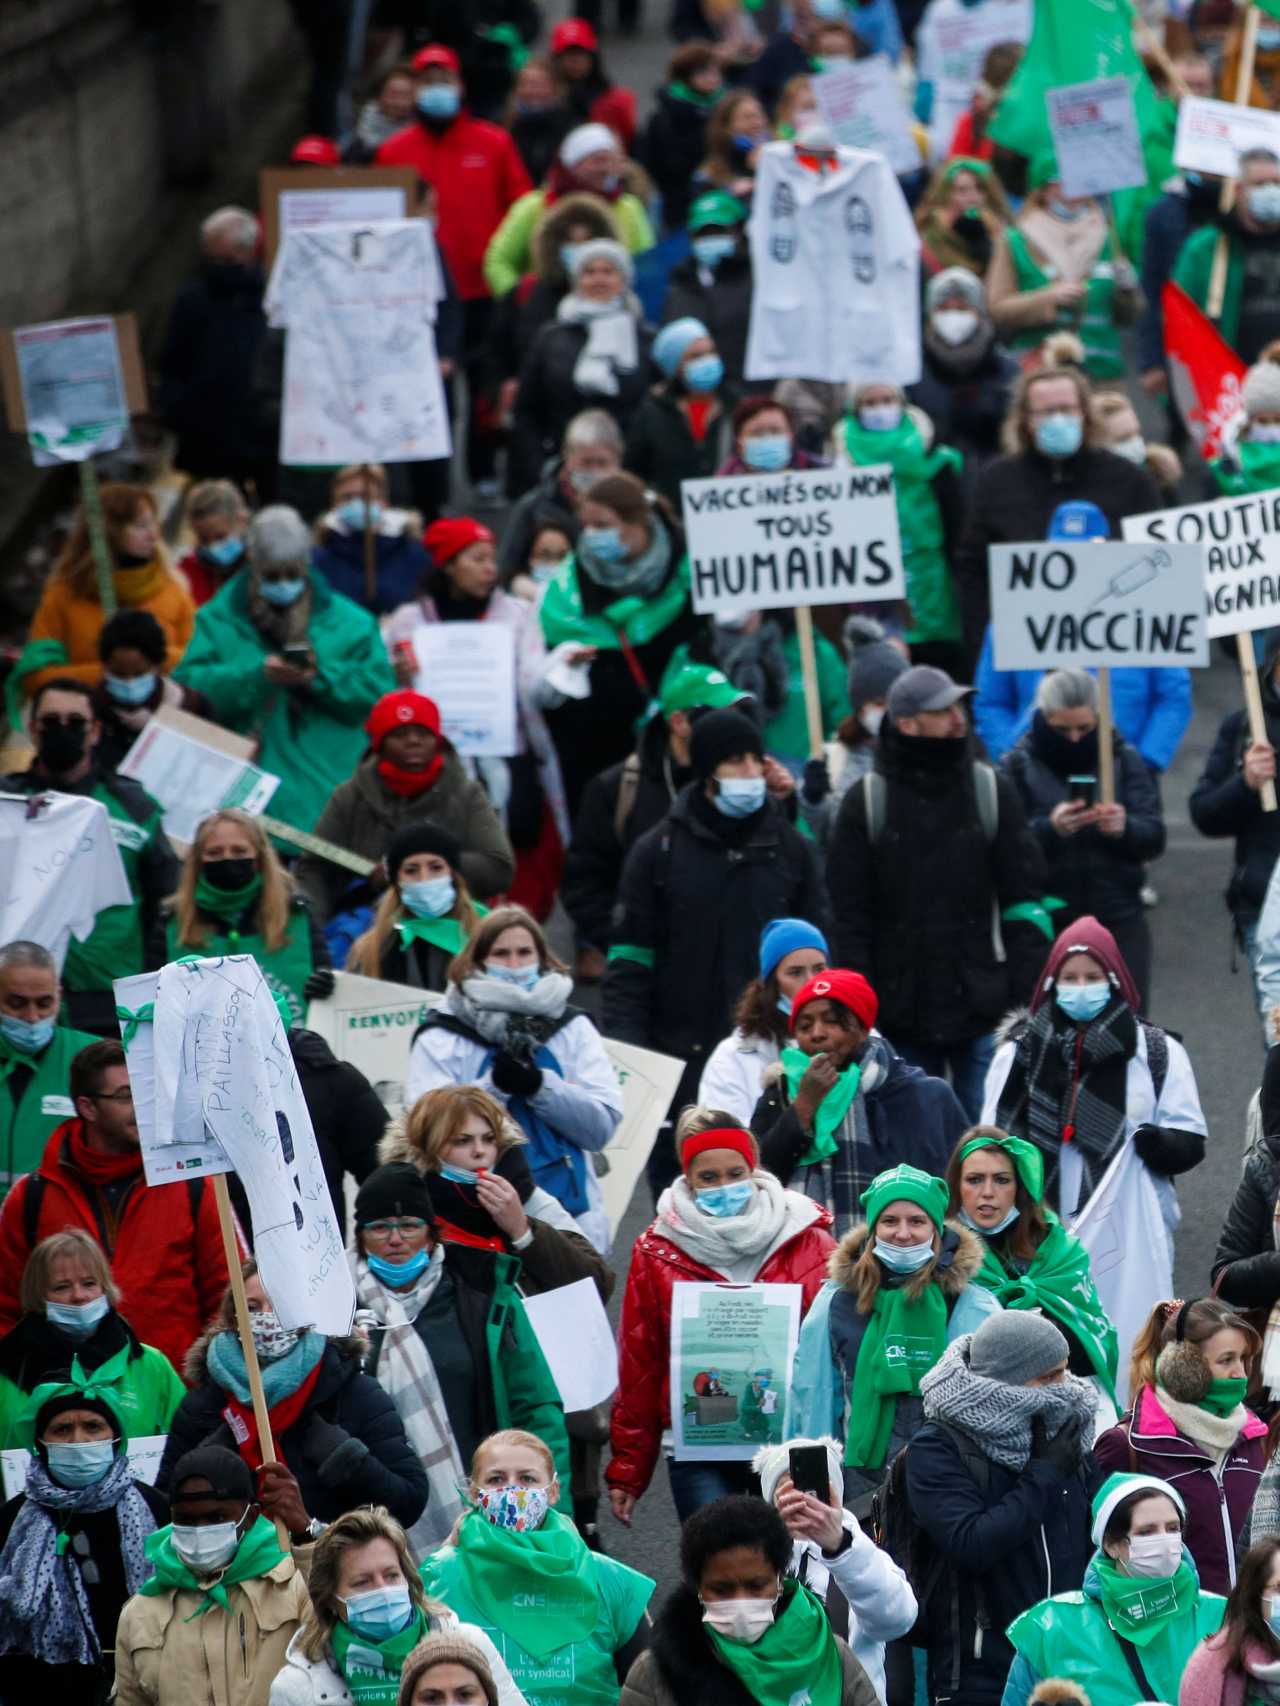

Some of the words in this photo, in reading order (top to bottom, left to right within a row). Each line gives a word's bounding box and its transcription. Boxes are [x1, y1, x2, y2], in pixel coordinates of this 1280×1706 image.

[813, 482, 844, 501] OU
[849, 474, 892, 499] NON
[757, 511, 833, 540] TOUS
[1008, 549, 1076, 591] NO
[1208, 539, 1266, 573] AUX
[513, 1593, 545, 1607] CNE
[528, 1667, 571, 1681] syndicat
